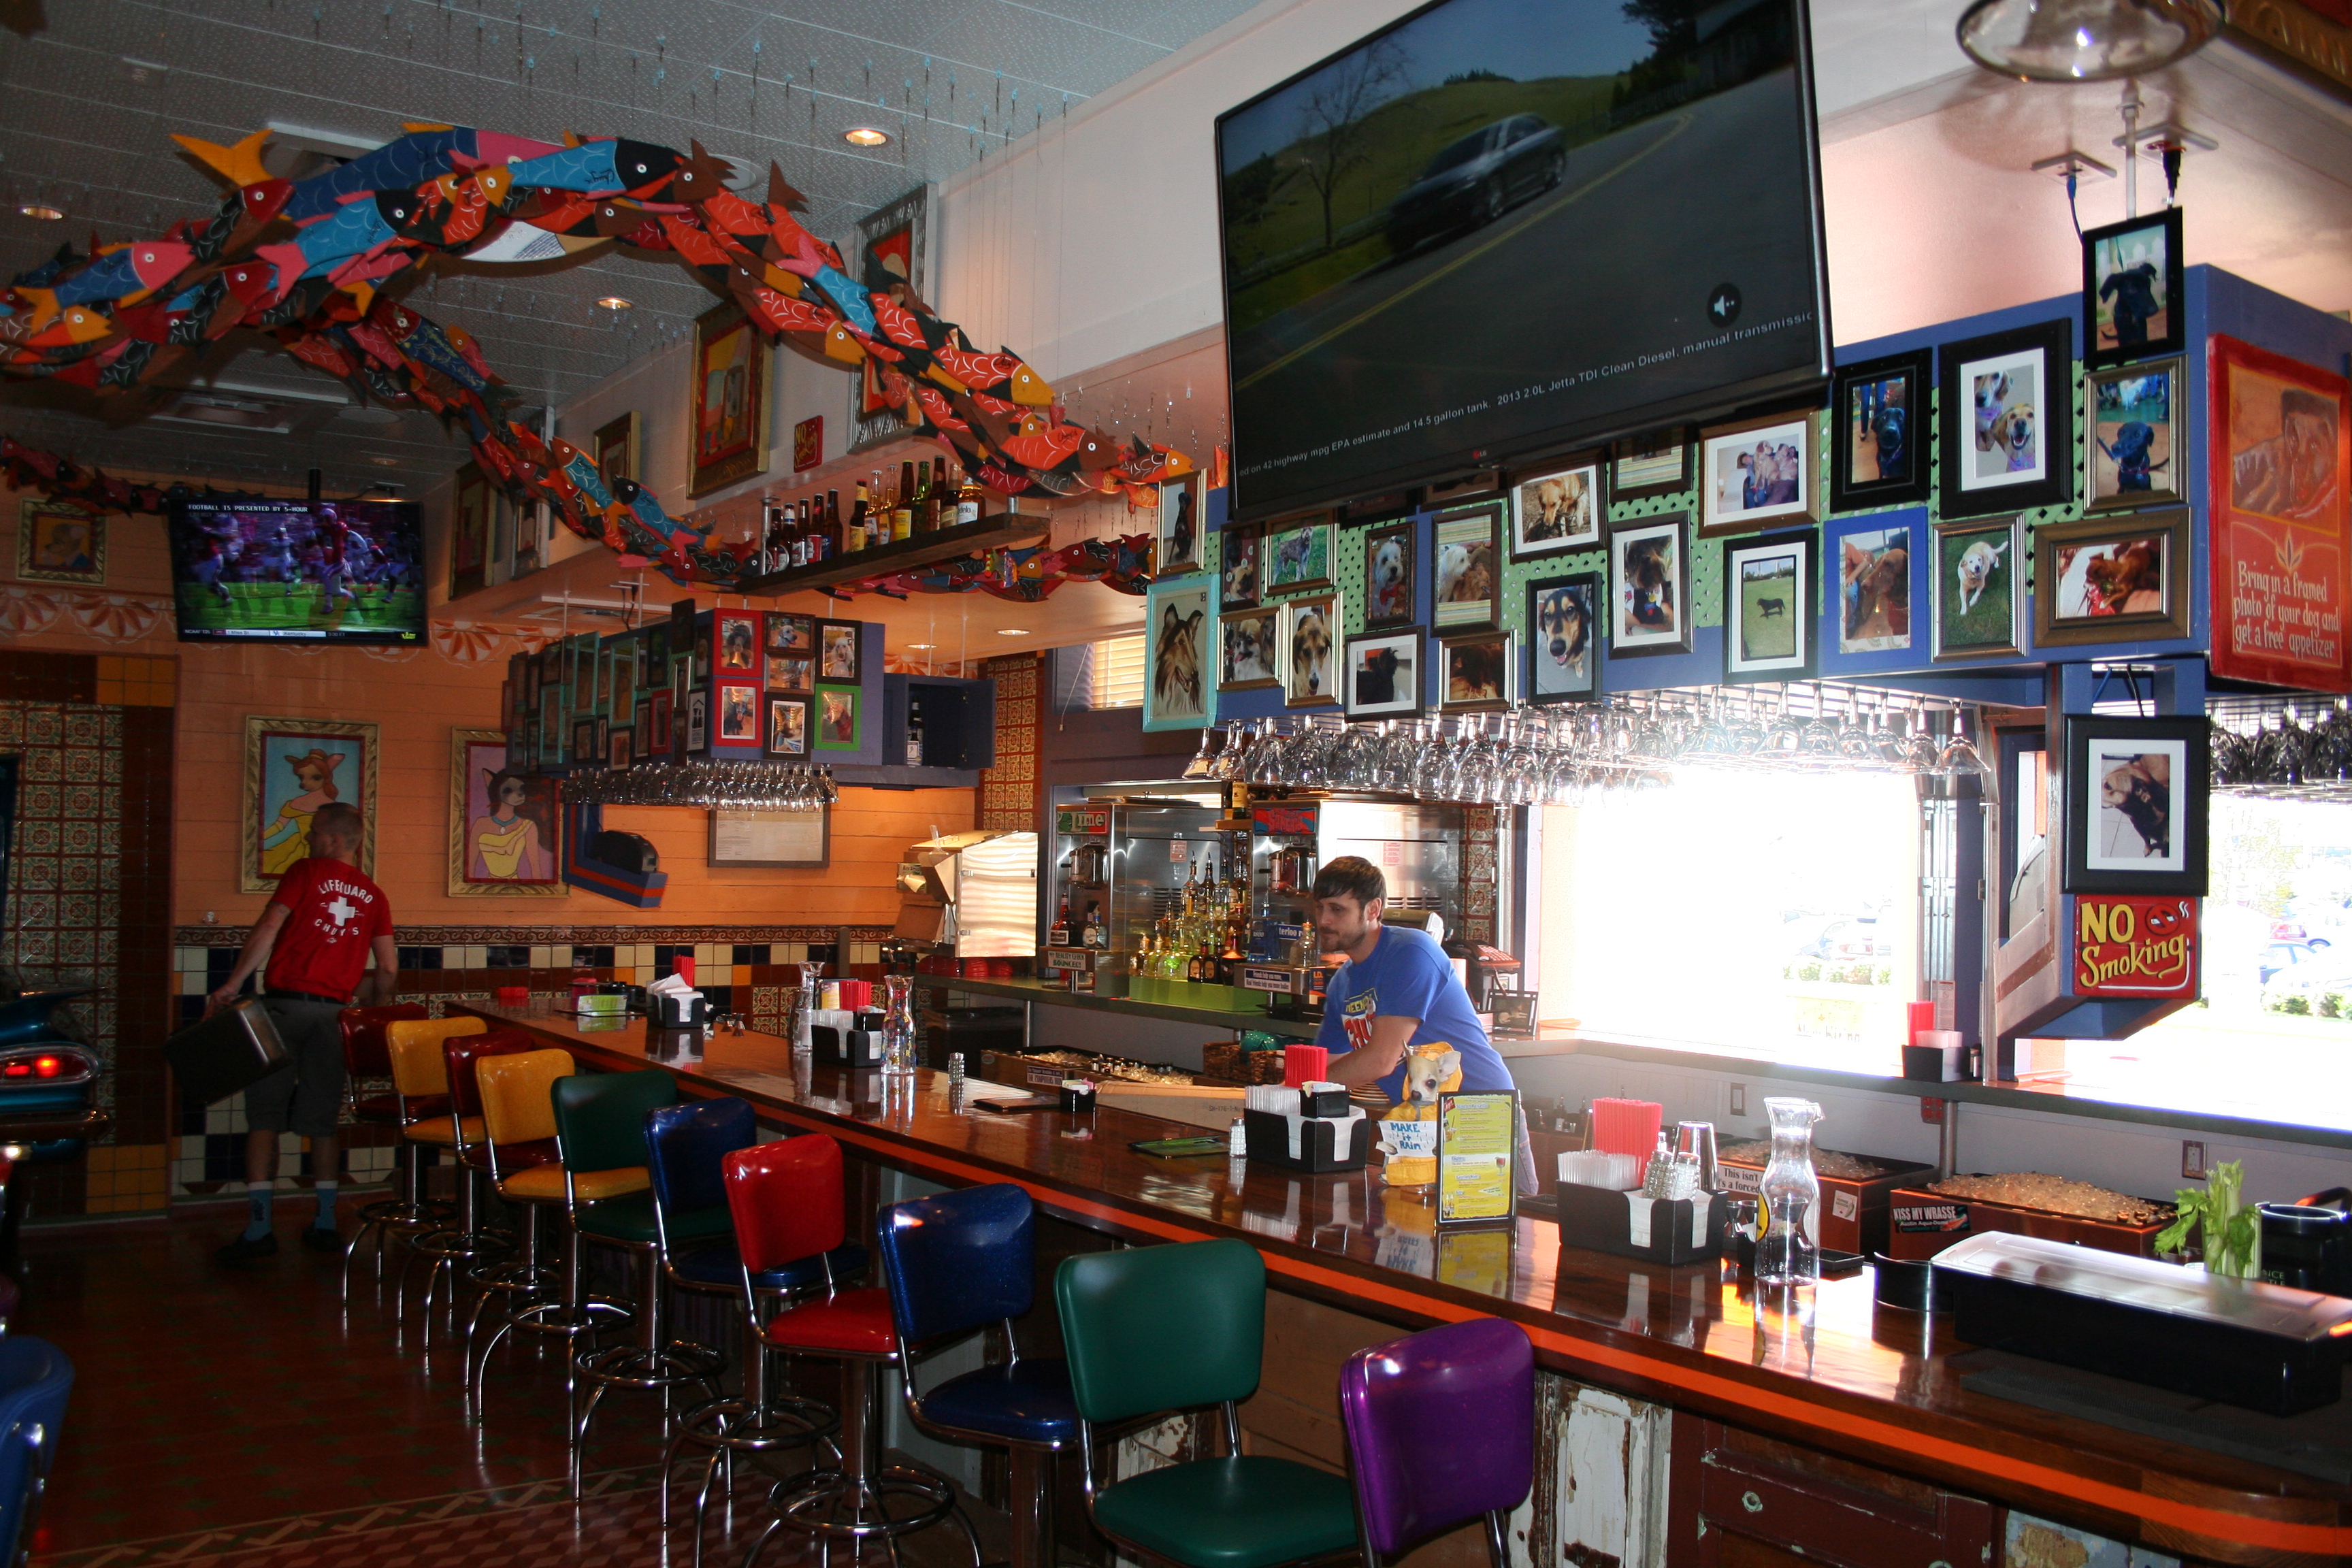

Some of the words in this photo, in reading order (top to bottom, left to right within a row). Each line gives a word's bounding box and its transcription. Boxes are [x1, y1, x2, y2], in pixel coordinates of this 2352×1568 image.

[1240, 466, 1250, 476] ed
[1251, 464, 1262, 474] on
[1262, 460, 1273, 470] 42
[1273, 451, 1309, 468] highway
[1310, 445, 1330, 457] mpg
[1331, 439, 1350, 452] EPA
[1352, 429, 1391, 446] estimate
[1392, 422, 1410, 435] and
[1413, 416, 1432, 429] 14.5
[1433, 406, 1465, 425] gallon
[1467, 399, 1492, 415] tank.
[1497, 391, 1521, 406] 2013
[1523, 384, 1546, 399] 2.0L
[1548, 377, 1575, 393] Jetta
[1578, 368, 1598, 382] TDI
[1601, 361, 1635, 377] Clean
[1683, 333, 1731, 355] manual
[2238, 560, 2270, 602] Bring
[2270, 565, 2281, 594] in
[2283, 576, 2291, 595] a
[2293, 572, 2328, 602] framed
[2234, 587, 2261, 621] photo
[2266, 593, 2276, 622] of
[2278, 604, 2301, 632] your
[2303, 601, 2319, 638] dog
[2322, 606, 2340, 632] and
[2235, 617, 2252, 652] get
[2255, 626, 2261, 647] a
[2264, 619, 2284, 650] free
[2289, 630, 2334, 660] appetizer
[318, 879, 374, 904] LIFEGUARD
[2080, 902, 2135, 943] NO
[2080, 934, 2185, 987] Smoking
[1390, 1122, 1420, 1132] MAKE
[1724, 1167, 1740, 1179] This
[1742, 1170, 1759, 1183] isn't
[1735, 1181, 1760, 1193] forced
[1911, 1207, 1923, 1220] MY
[1923, 1205, 1957, 1220] WRASSE
